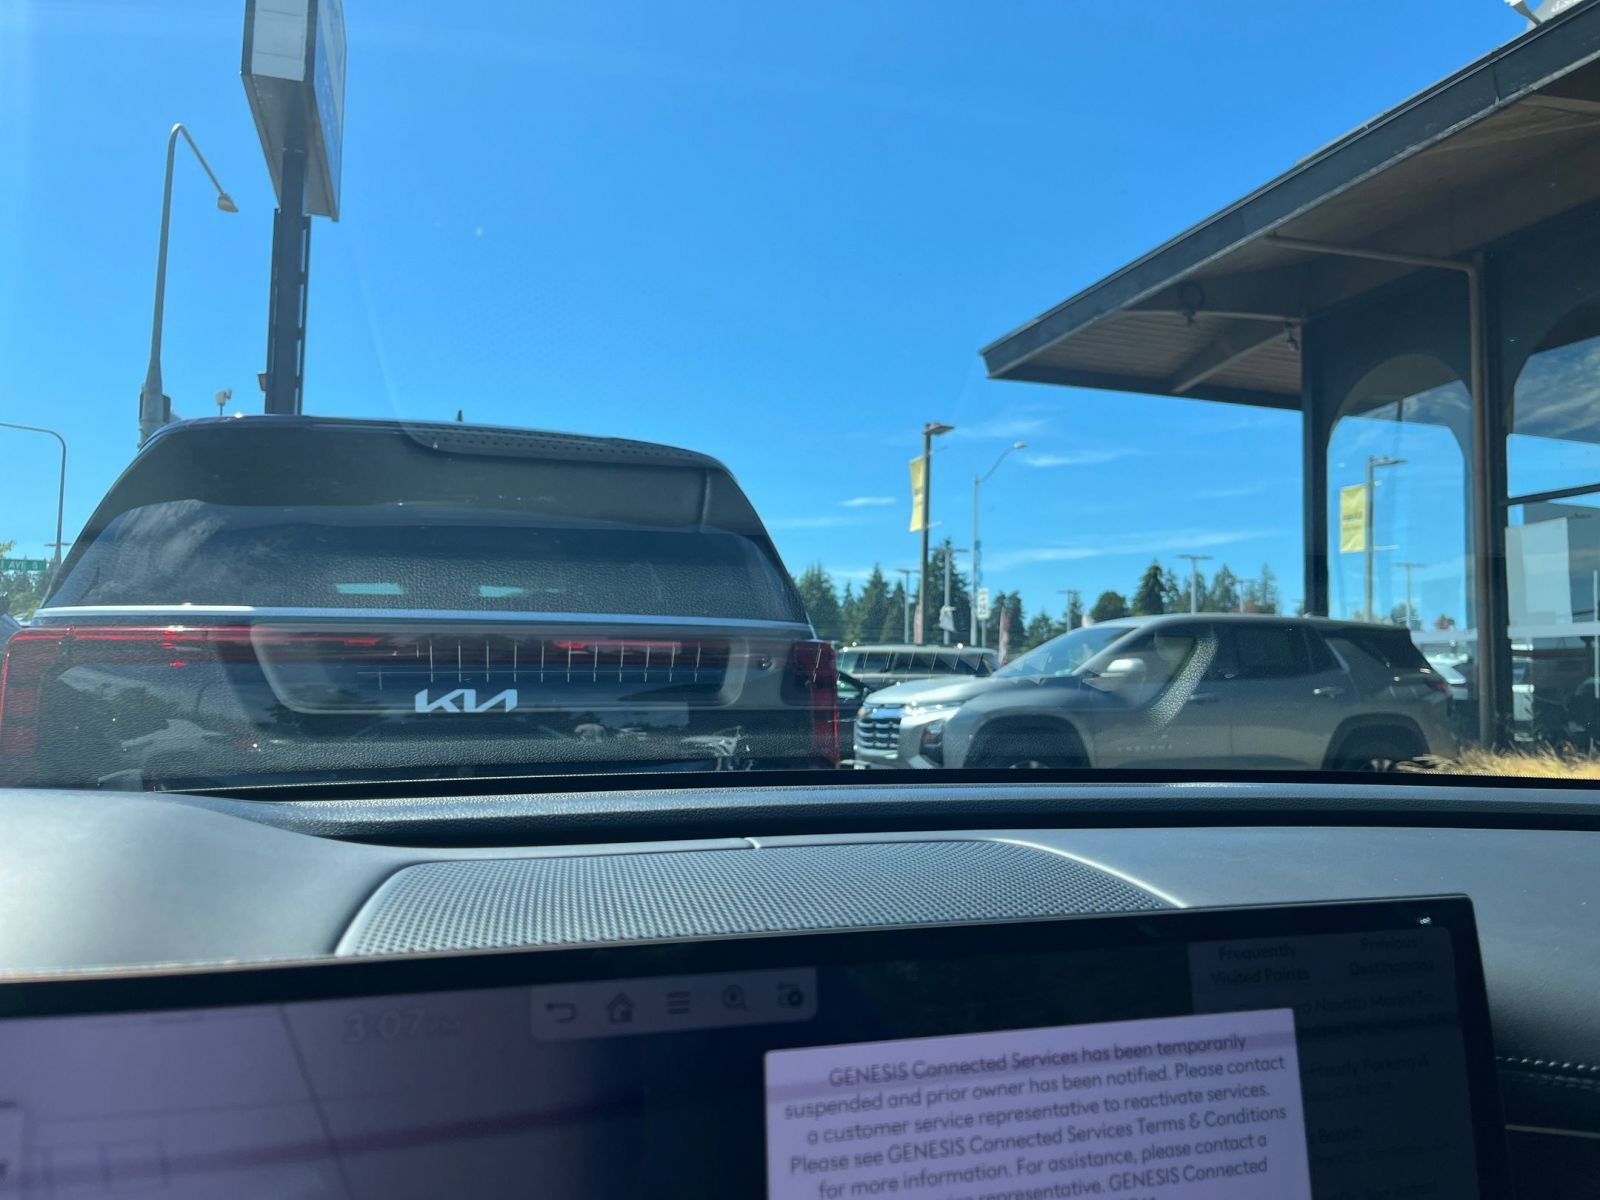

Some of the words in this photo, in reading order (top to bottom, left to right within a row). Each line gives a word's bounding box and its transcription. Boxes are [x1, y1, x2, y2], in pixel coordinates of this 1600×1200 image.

[415, 688, 519, 713] KIA
[1210, 968, 1262, 986] Visited
[1264, 966, 1311, 983] Points
[1218, 942, 1297, 961] Frequently
[829, 1062, 908, 1087] GENESIS
[912, 1053, 1008, 1080] Connected
[1012, 1048, 1078, 1070] Services
[1082, 1045, 1110, 1062] has
[1114, 1041, 1153, 1060] been
[1156, 1034, 1247, 1056] temporarily
[784, 1091, 884, 1120] suspended
[888, 1088, 921, 1109] and
[926, 1085, 969, 1109] prior
[972, 1082, 1025, 1098] owner
[1029, 1077, 1058, 1094] has
[1062, 1073, 1102, 1092] been
[1105, 1065, 1171, 1086] notified.
[1175, 1061, 1223, 1080] Please
[1227, 1056, 1286, 1074] contact
[807, 1130, 818, 1146] a
[823, 1120, 909, 1144] customer
[914, 1113, 975, 1134] service
[978, 1098, 1100, 1129] representative
[1104, 1097, 1120, 1114] to
[1123, 1088, 1204, 1110] reactivate
[1207, 1082, 1271, 1102] services.
[789, 1155, 850, 1177] Please
[854, 1152, 884, 1167] see
[887, 1138, 966, 1165] GENESIS
[970, 1129, 1063, 1154] Connected
[1067, 1121, 1133, 1144] Services
[1137, 1116, 1186, 1136] Terms
[1189, 1112, 1201, 1130] &
[1203, 1106, 1287, 1129] Conditions
[819, 1180, 845, 1200] for
[850, 1177, 899, 1197] more
[902, 1163, 1012, 1190] information.
[1016, 1157, 1043, 1177] For
[1049, 1148, 1138, 1173] assistance,
[1141, 1142, 1192, 1165] please
[1195, 1133, 1255, 1155] contact
[1258, 1135, 1268, 1148] a
[1109, 1166, 1180, 1192] GENESIS
[1182, 1157, 1268, 1184] Connected
